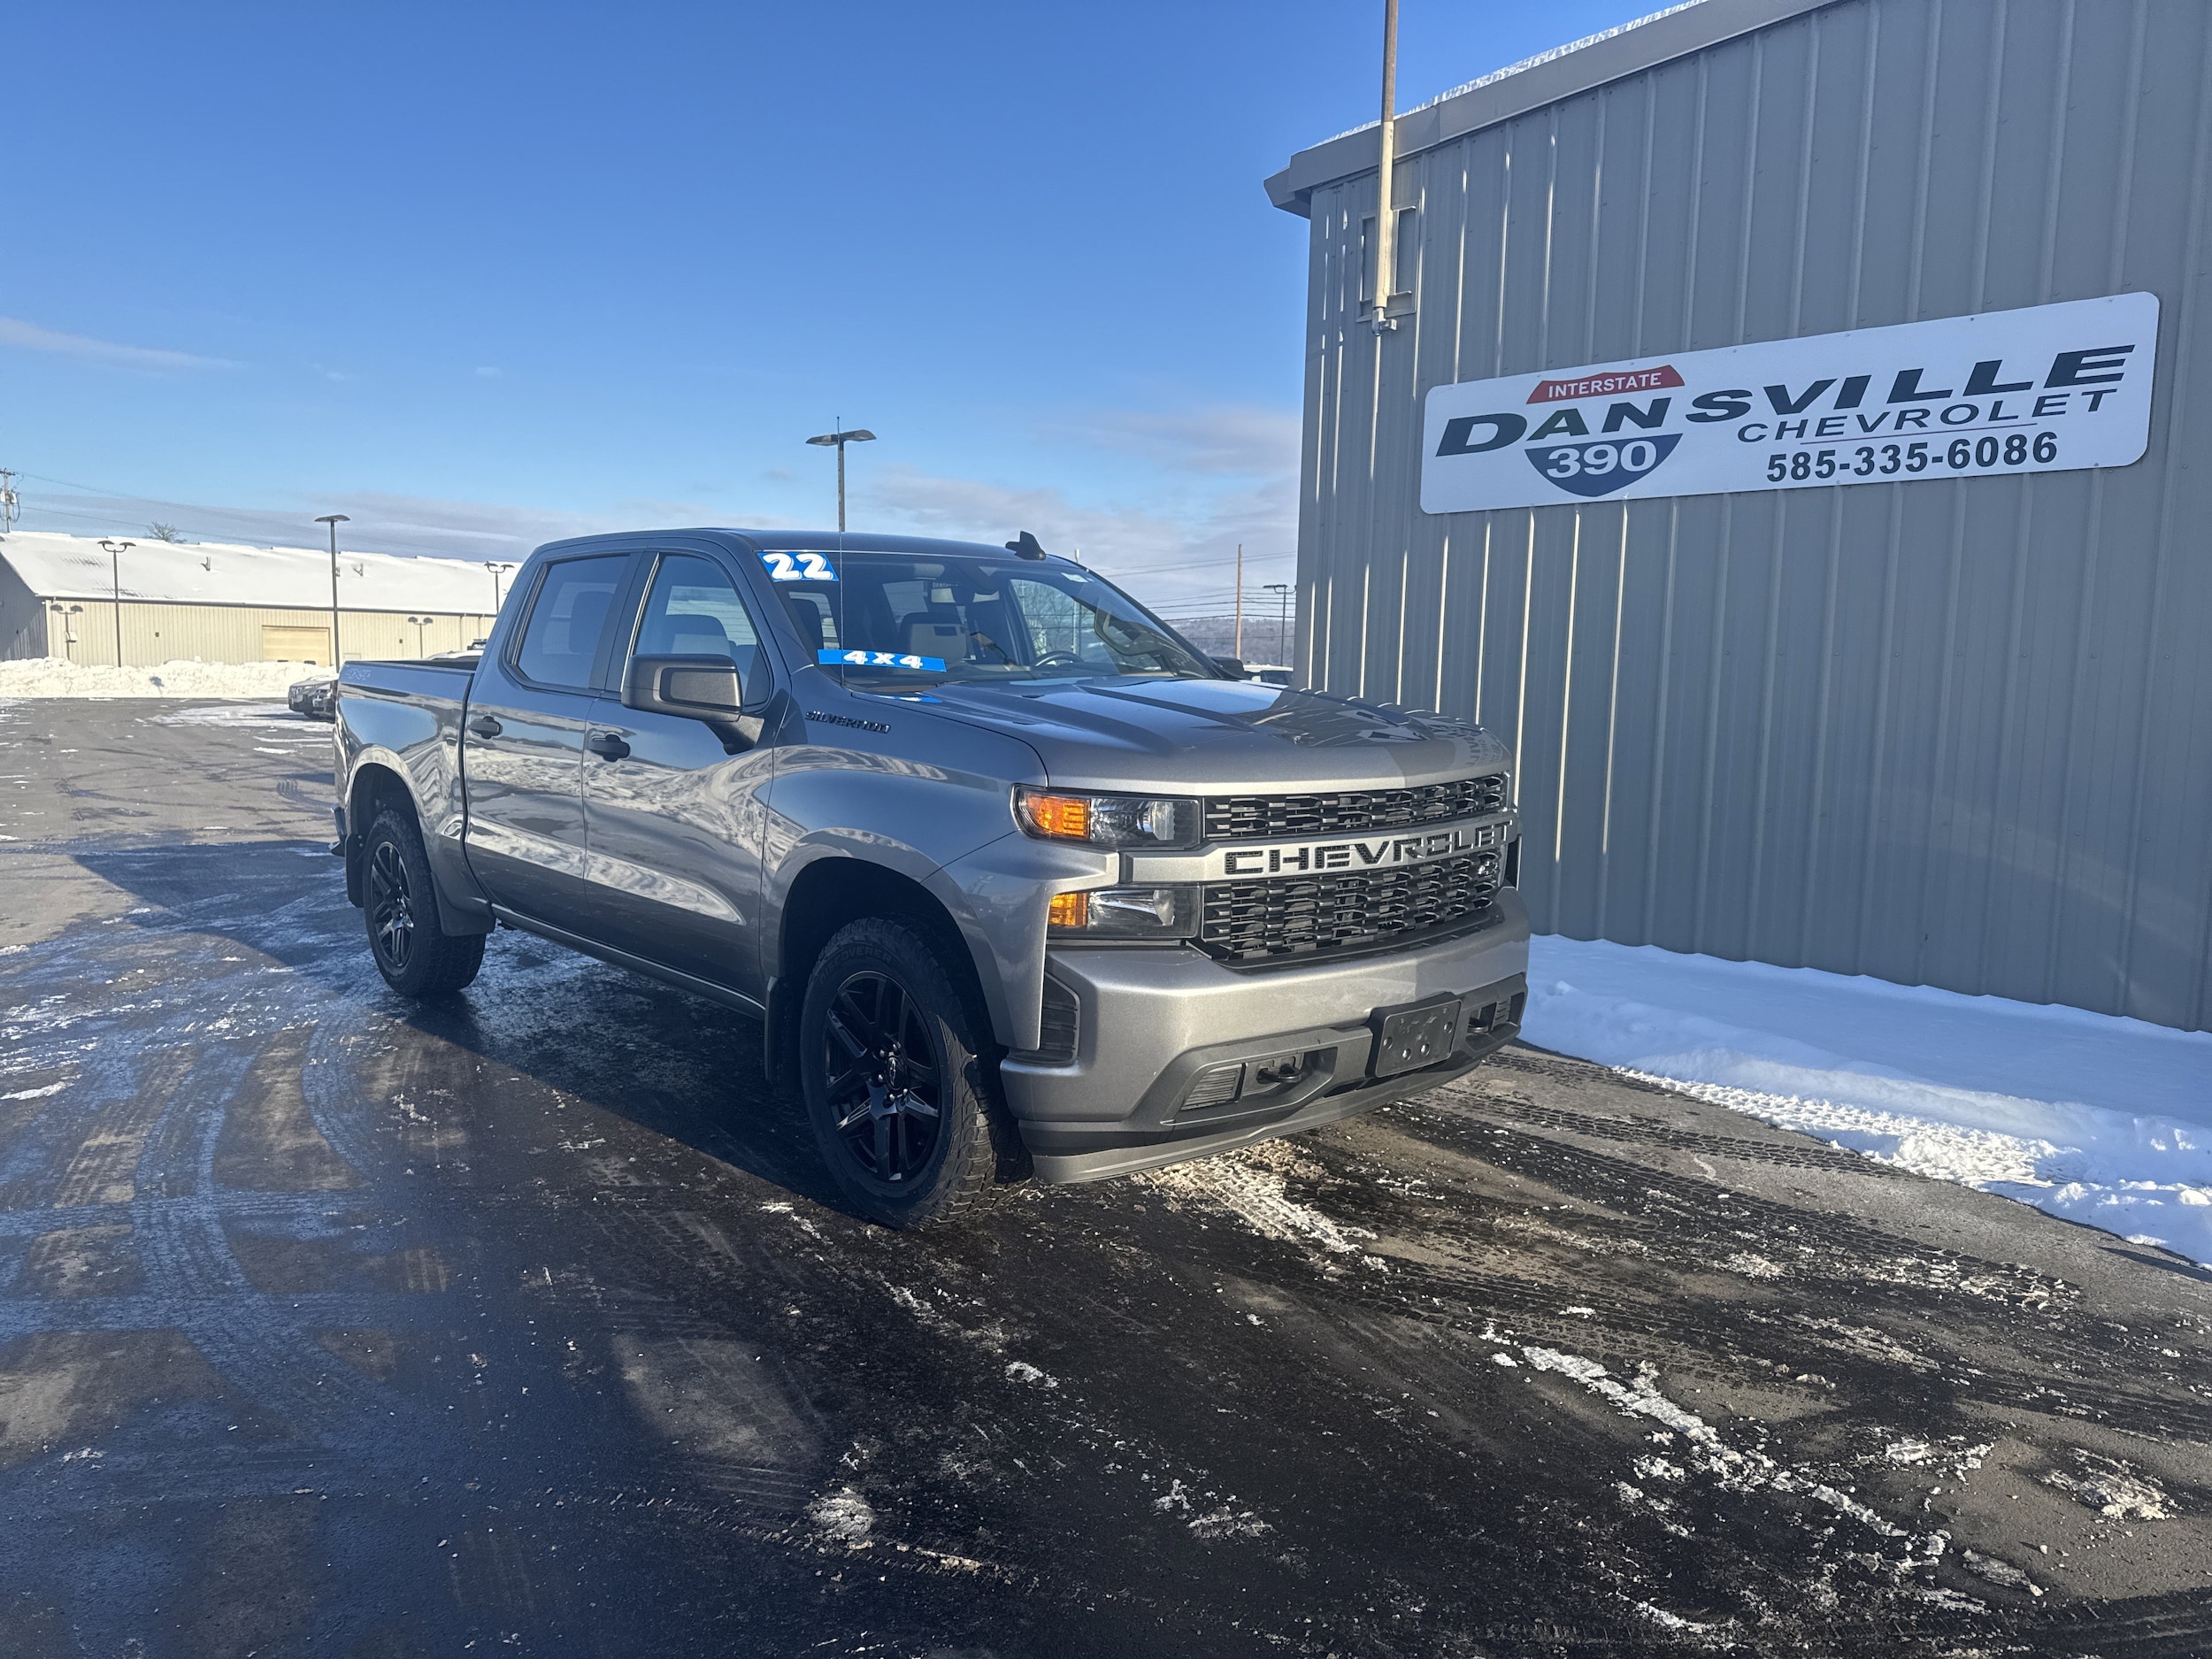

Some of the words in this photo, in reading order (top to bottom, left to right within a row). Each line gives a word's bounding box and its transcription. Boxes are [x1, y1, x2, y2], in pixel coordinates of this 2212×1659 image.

[1436, 344, 2136, 457] DANSVILLE
[1547, 373, 1663, 400] INTERSTATE
[1737, 389, 2118, 444] CHEVROLET
[1546, 438, 1657, 477] 390
[1766, 431, 2059, 482] 585-335-6086
[763, 552, 834, 580] 22
[1224, 819, 1513, 876] CHEVROLET
